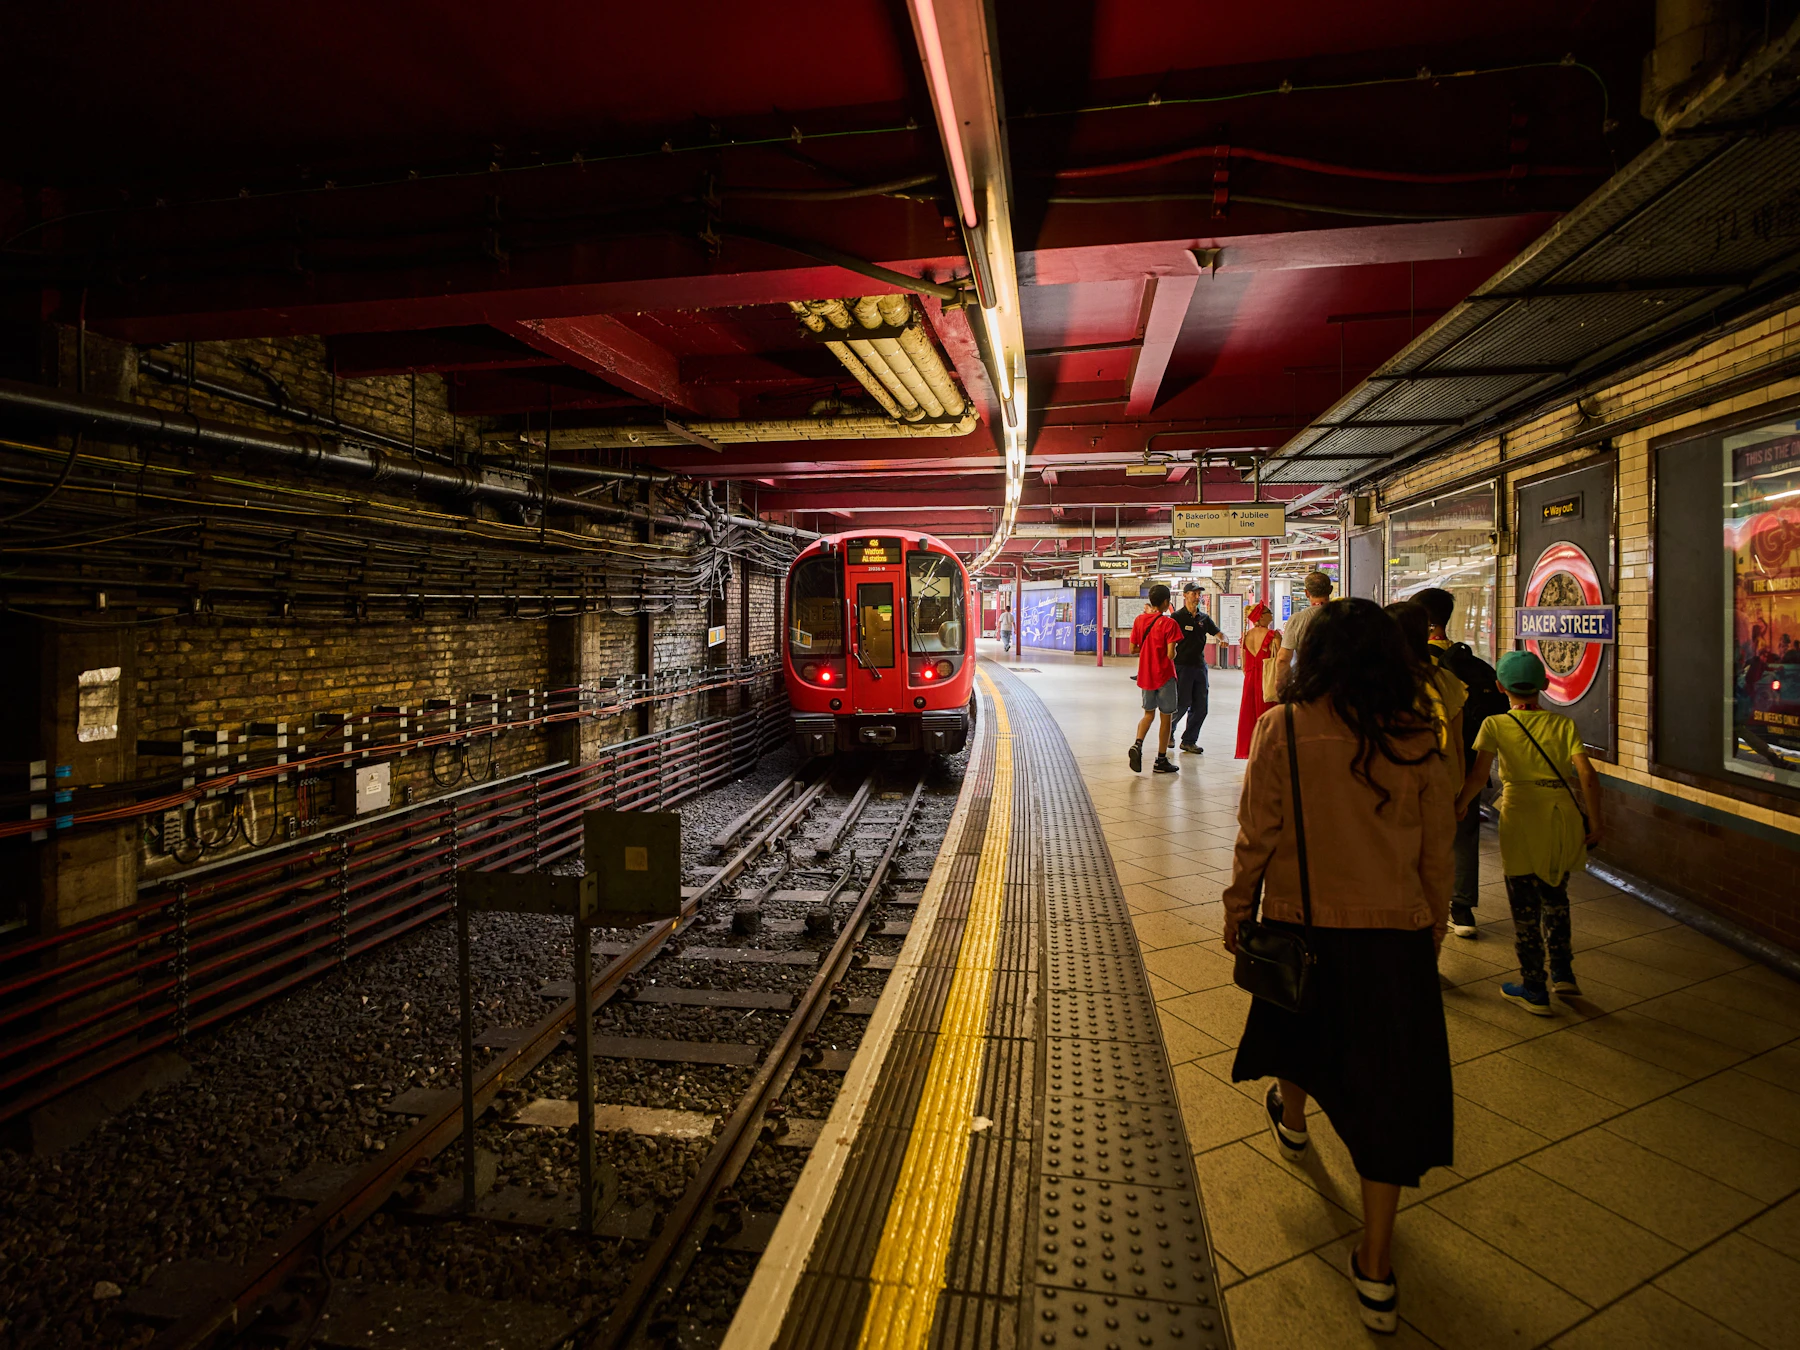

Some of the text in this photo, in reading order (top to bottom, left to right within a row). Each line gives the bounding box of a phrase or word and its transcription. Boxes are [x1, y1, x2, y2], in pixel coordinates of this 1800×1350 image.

[1745, 450, 1764, 466] THIS
[1764, 447, 1773, 463] IS
[1774, 443, 1790, 460] THE
[1185, 512, 1220, 520] Bakerloo
[1240, 511, 1269, 519] Jubilee
[1550, 502, 1574, 517] Way out
[1099, 561, 1112, 569] Way
[1753, 580, 1766, 593] THE
[1521, 614, 1557, 633] BAKER
[1560, 614, 1606, 634] STREET
[1754, 710, 1763, 720] SIX
[1763, 712, 1783, 724] WEEKS
